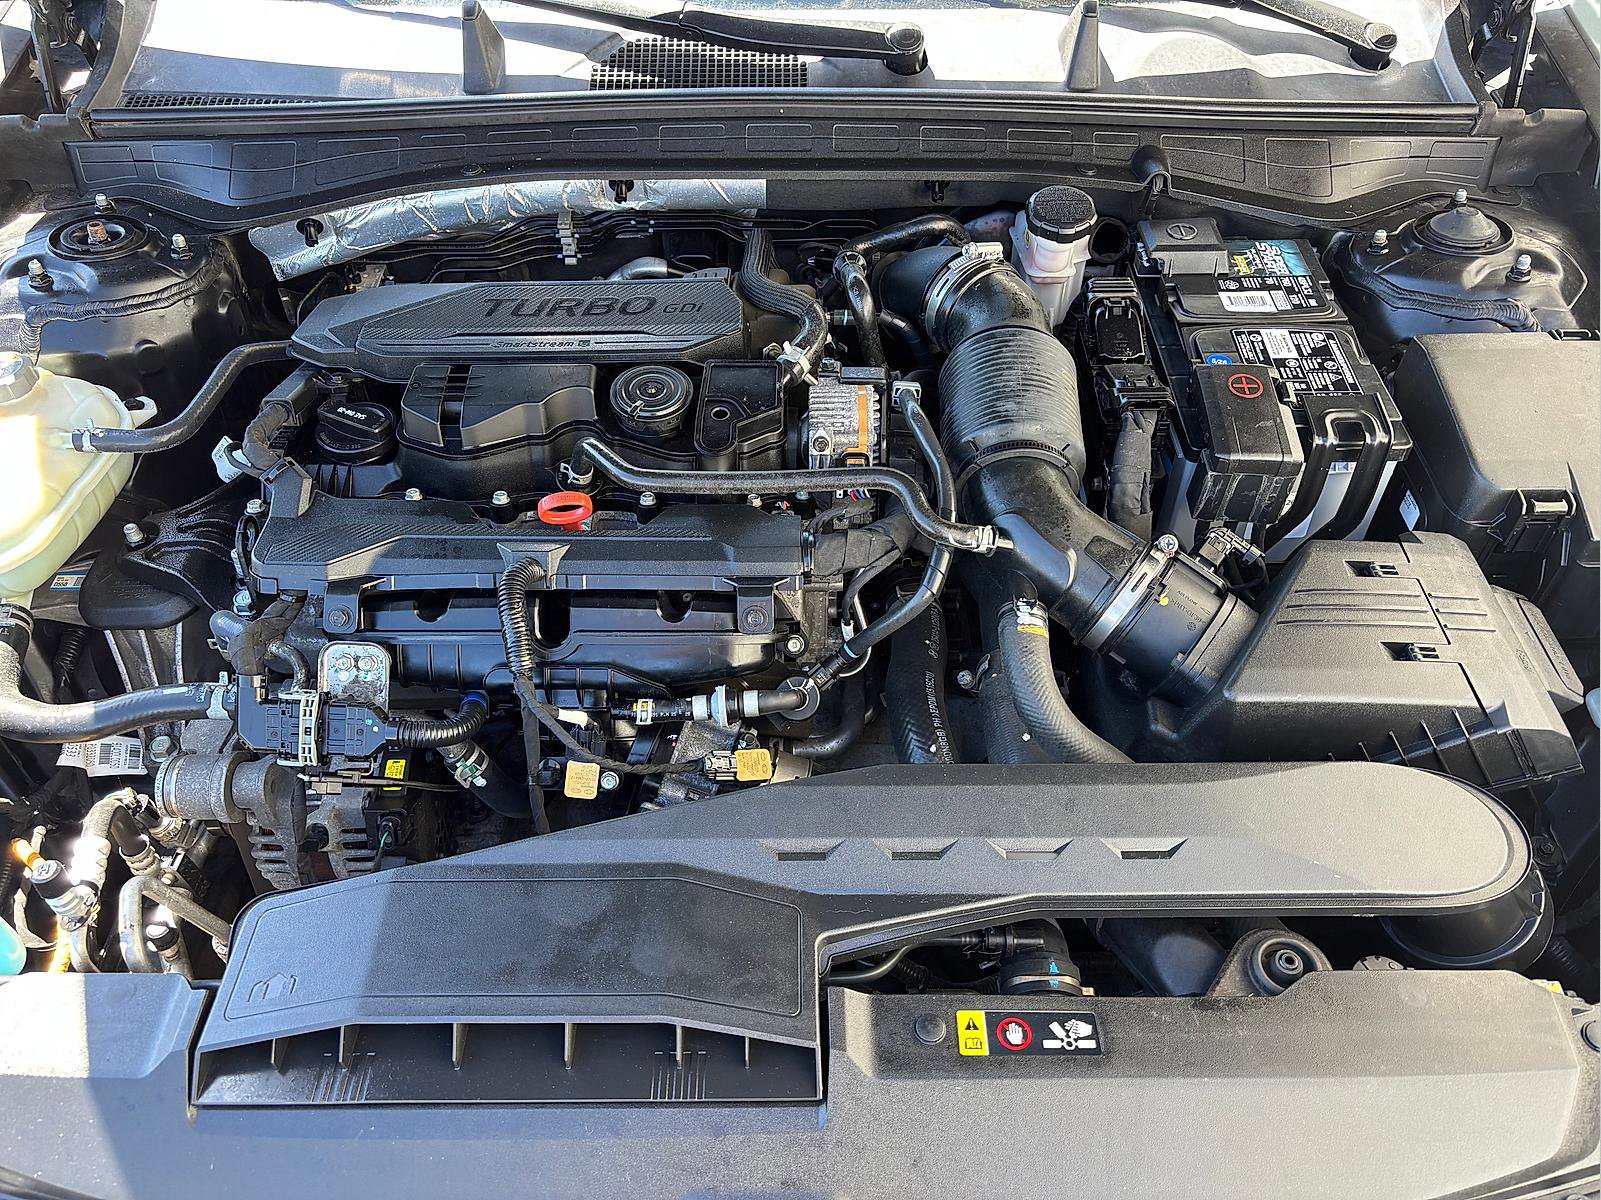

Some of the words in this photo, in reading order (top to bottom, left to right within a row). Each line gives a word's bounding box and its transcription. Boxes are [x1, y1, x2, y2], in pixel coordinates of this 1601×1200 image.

[1254, 241, 1278, 276] START
[1270, 244, 1290, 276] SUPER
[483, 296, 658, 318] TURBO
[662, 302, 706, 314] GDi
[491, 339, 575, 349] Smartstream
[353, 412, 368, 420] SAE
